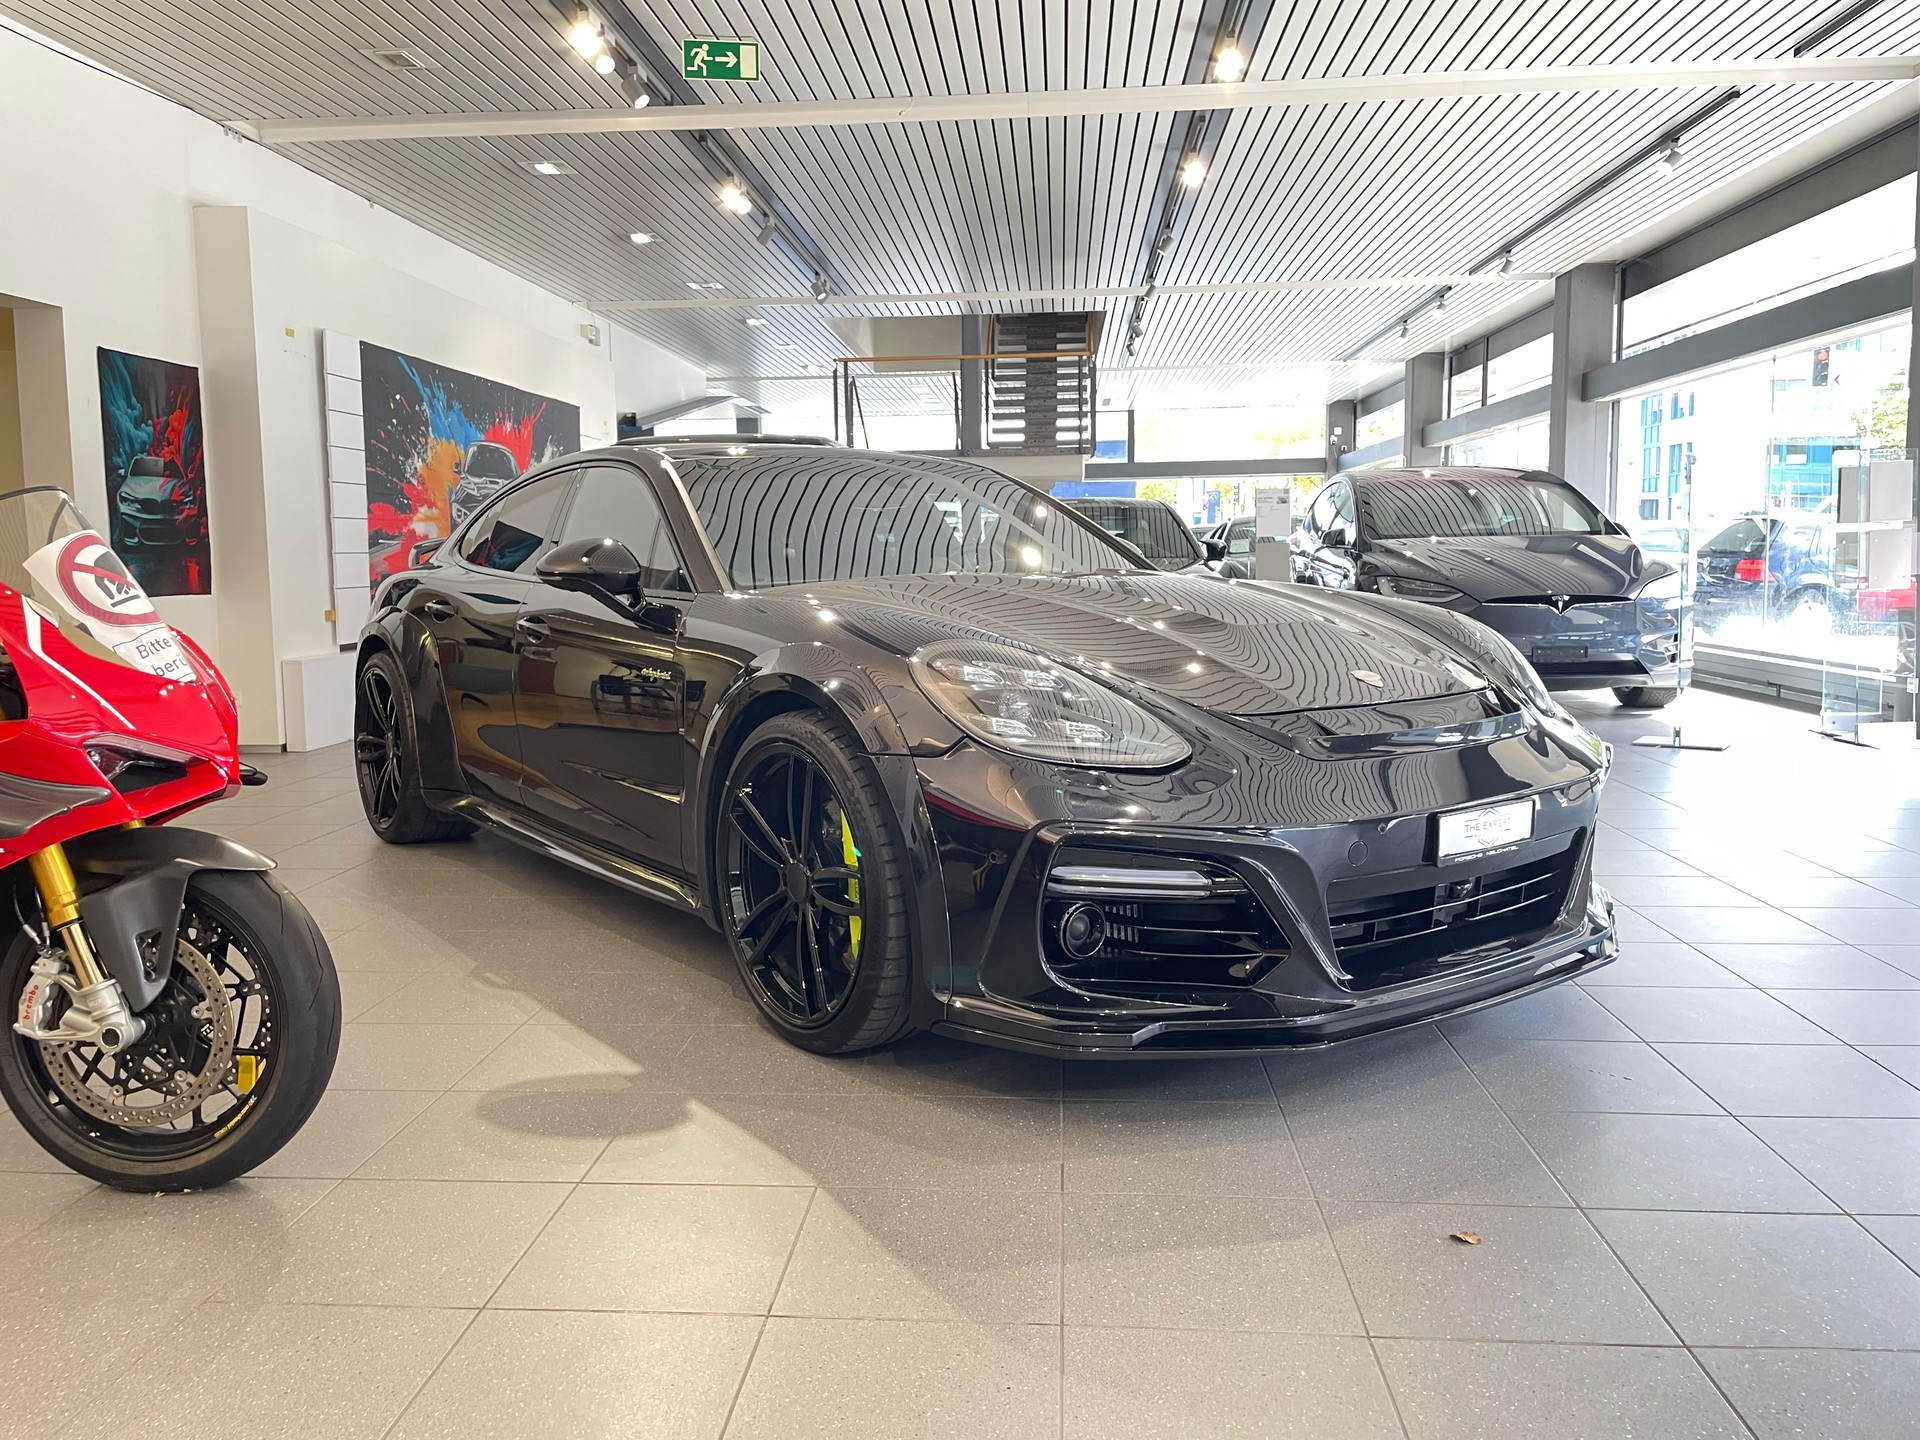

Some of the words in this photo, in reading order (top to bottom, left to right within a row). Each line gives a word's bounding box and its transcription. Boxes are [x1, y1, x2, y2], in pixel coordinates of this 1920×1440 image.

[136, 638, 172, 659] Bitte
[1465, 822, 1480, 832] THE
[23, 984, 39, 1020] brembo
